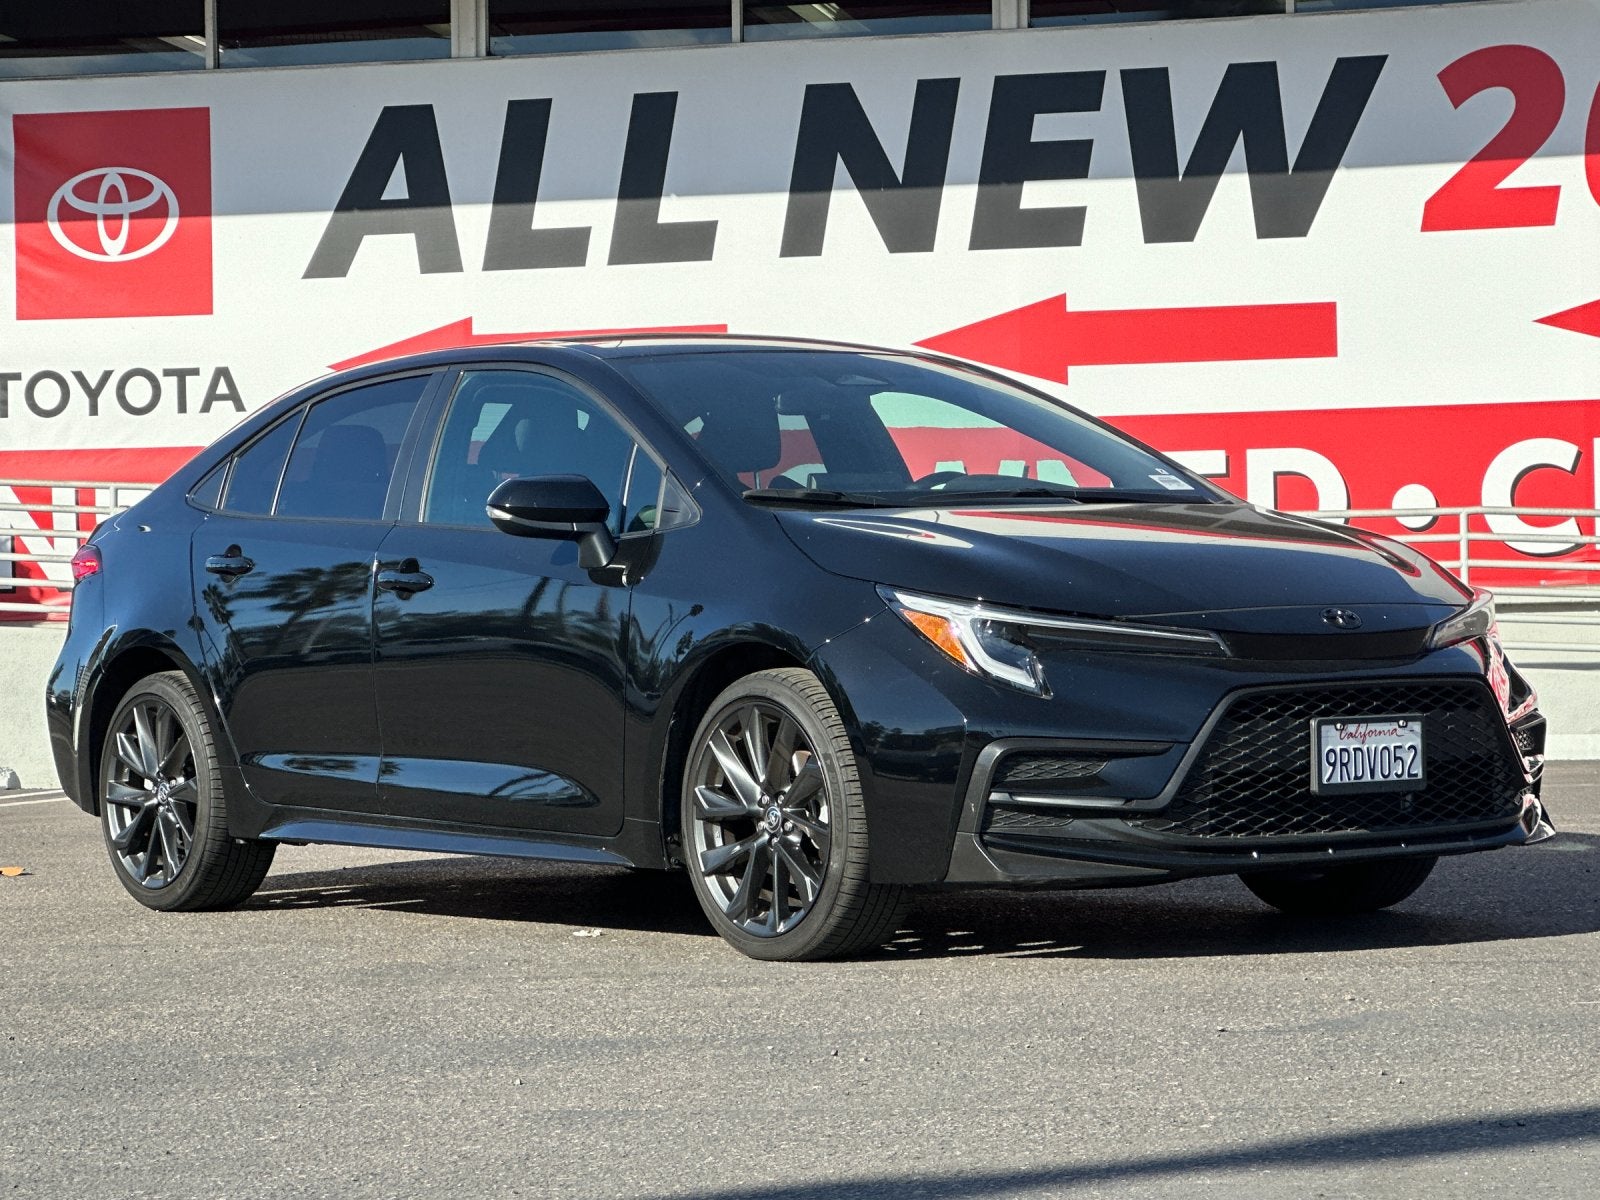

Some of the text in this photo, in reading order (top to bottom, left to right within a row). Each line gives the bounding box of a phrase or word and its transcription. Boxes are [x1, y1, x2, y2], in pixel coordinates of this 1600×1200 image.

[301, 44, 1600, 279] ALL NEW 2
[0, 366, 247, 419] TOYOTA
[1339, 722, 1405, 745] California
[1325, 744, 1419, 783] 9RDV052
